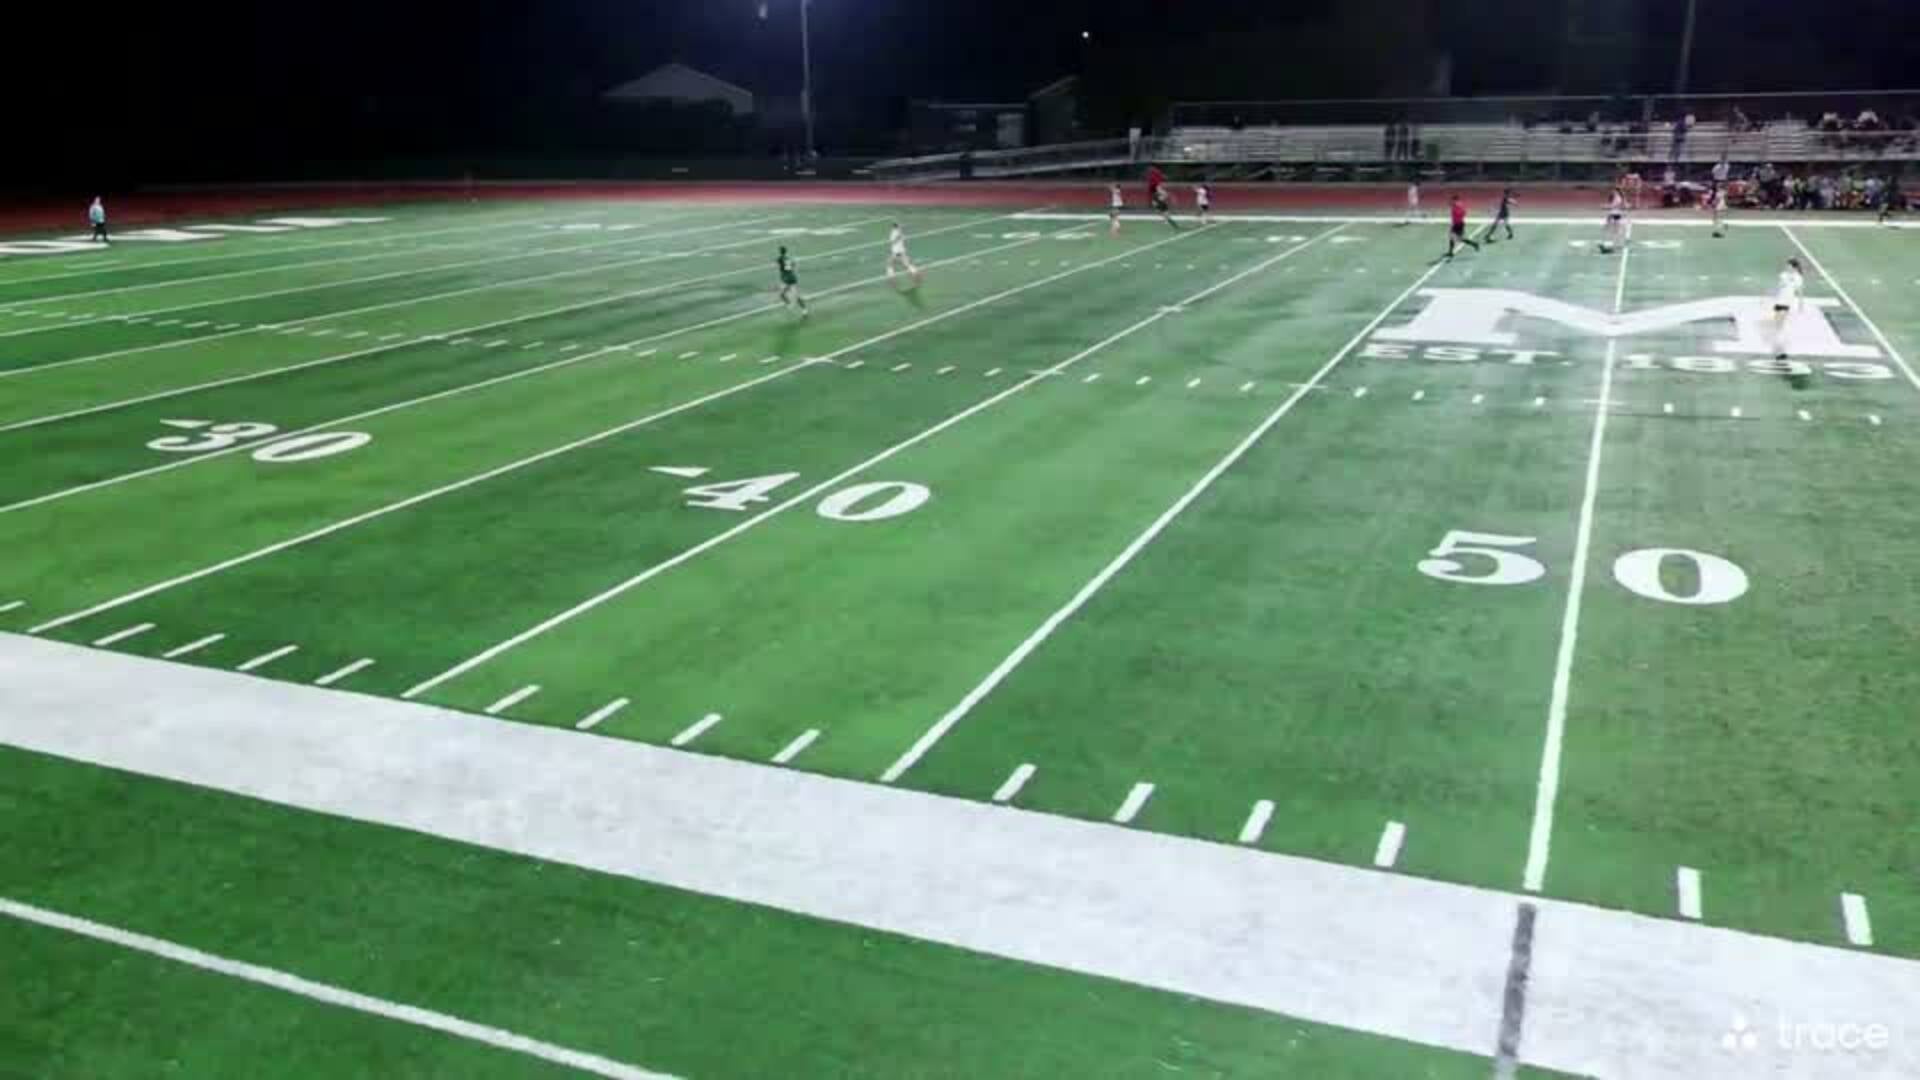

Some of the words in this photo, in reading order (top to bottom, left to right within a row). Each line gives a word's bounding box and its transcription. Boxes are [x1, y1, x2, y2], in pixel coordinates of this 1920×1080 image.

[1369, 286, 1881, 357] M
[147, 421, 372, 462] 30
[683, 471, 931, 521] 40
[1417, 529, 1750, 605] 50
